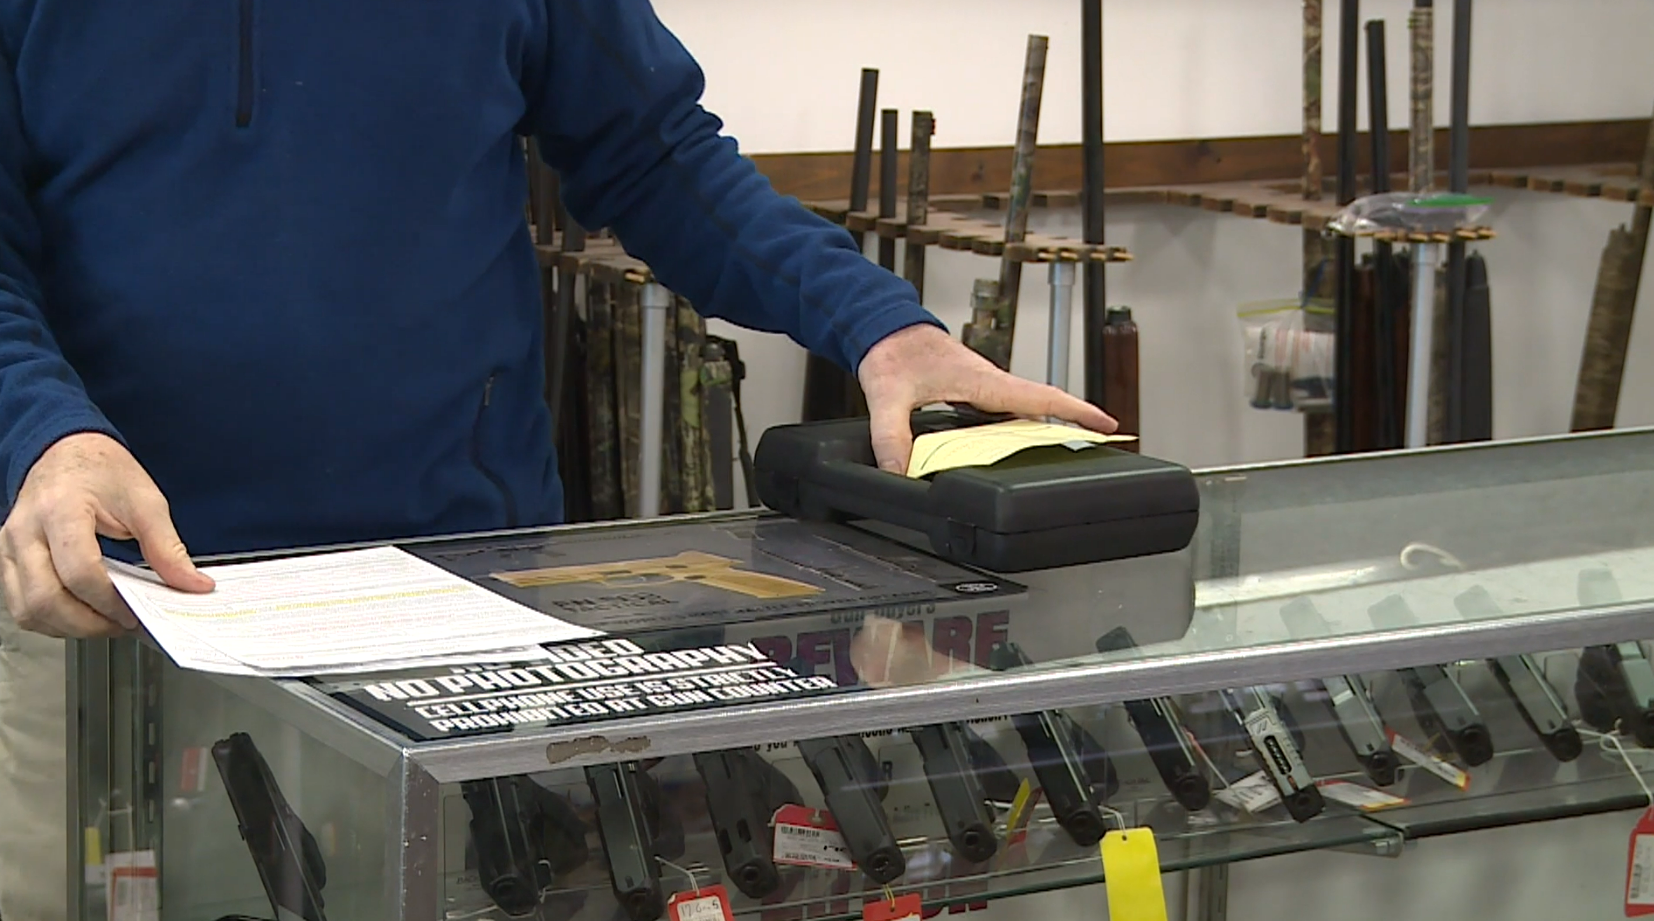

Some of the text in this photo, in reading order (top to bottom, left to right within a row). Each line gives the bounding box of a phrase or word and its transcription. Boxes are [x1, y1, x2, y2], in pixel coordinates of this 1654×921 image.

[363, 642, 768, 701] NO PHOTOGRAPHY
[536, 638, 645, 664] IDEO
[415, 666, 800, 718] CELLPHONE USE IS STRICTLY
[429, 675, 838, 732] PROHIBITED AT GUN COUNTER
